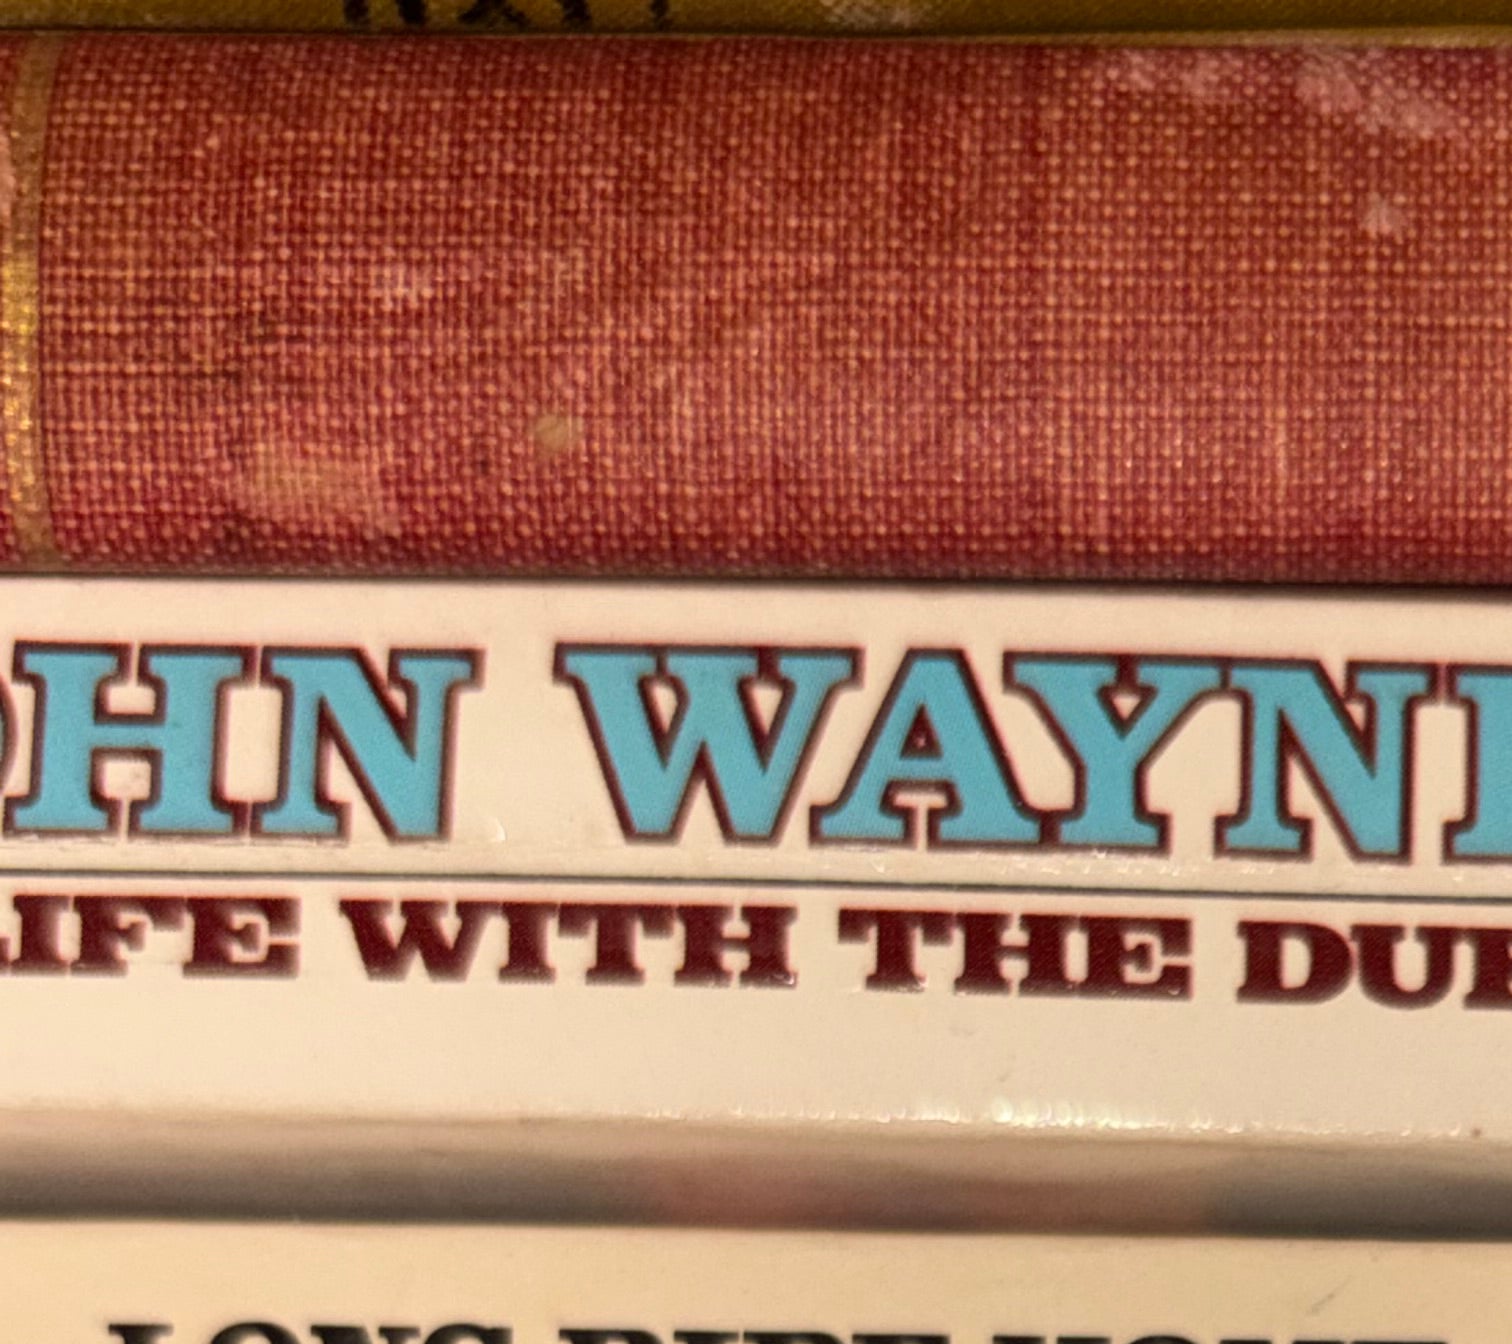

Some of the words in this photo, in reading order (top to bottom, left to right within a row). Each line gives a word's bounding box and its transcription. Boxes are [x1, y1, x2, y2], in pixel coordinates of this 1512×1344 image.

[0, 638, 487, 841] HN
[0, 893, 301, 979] IFE
[338, 896, 798, 990] WITH
[837, 906, 1194, 1001] THE
